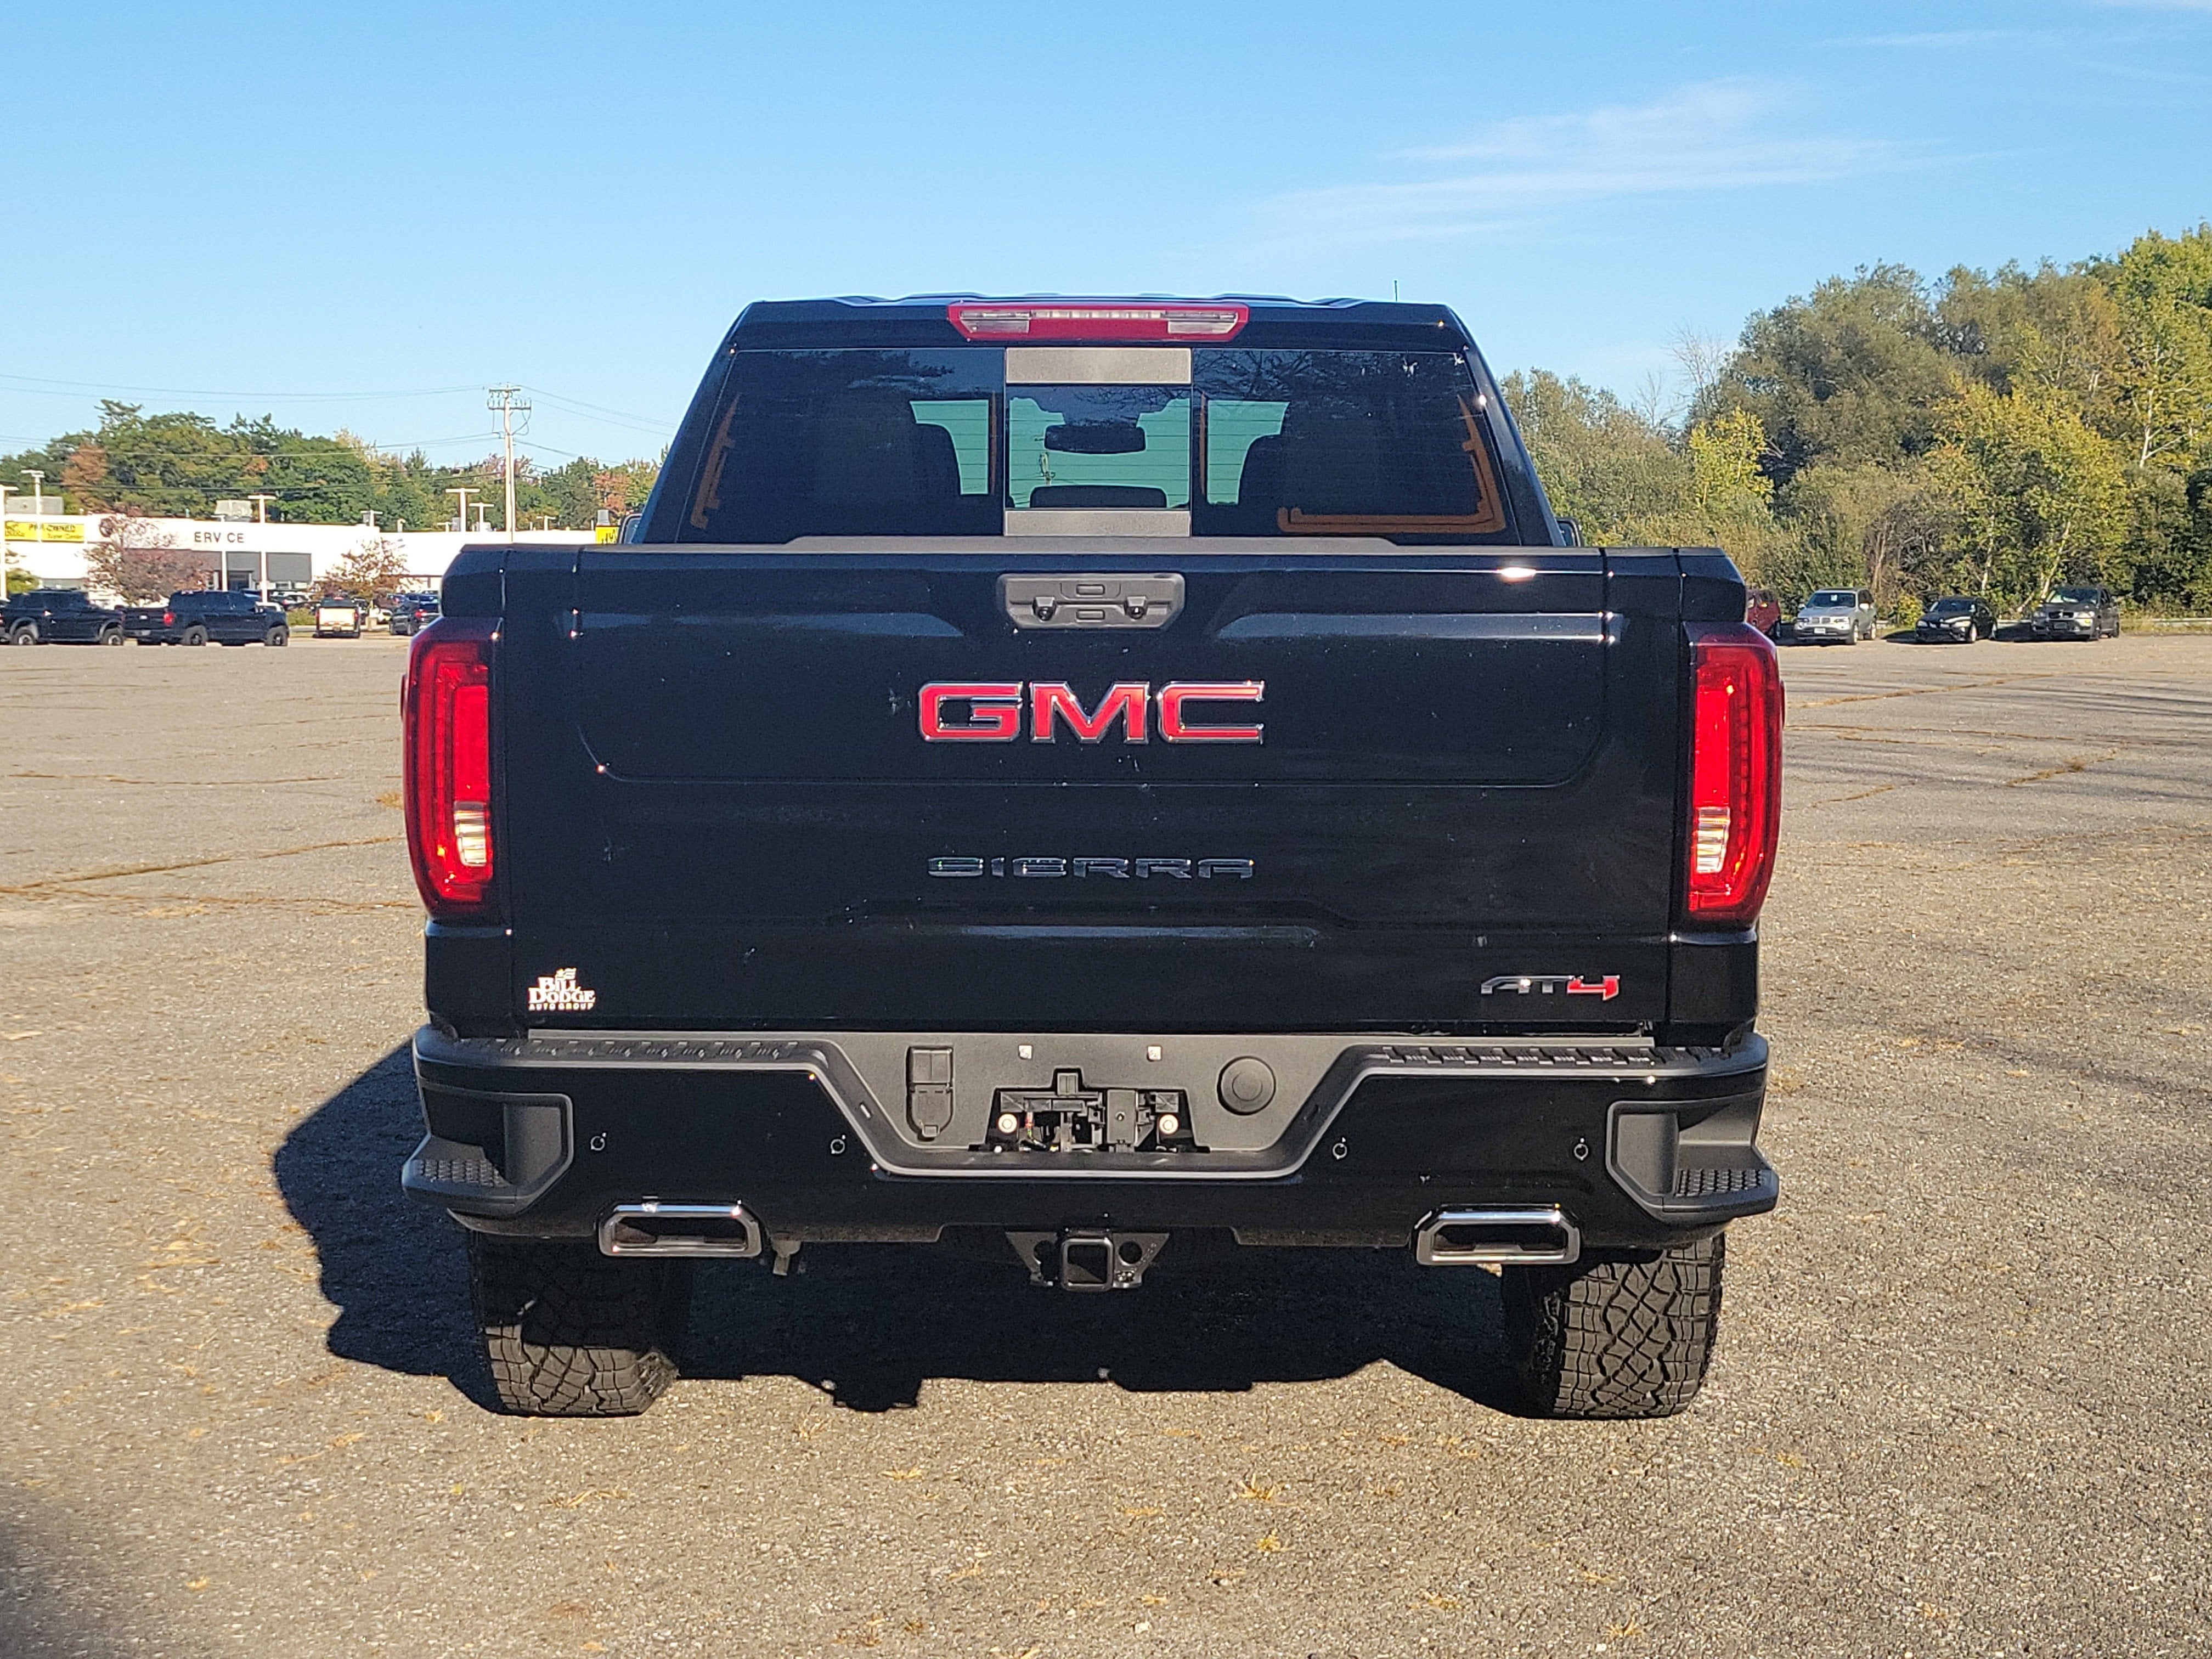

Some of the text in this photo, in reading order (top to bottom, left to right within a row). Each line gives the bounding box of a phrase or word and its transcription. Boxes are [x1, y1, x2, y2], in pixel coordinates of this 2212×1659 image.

[918, 680, 1265, 743] GMC
[928, 856, 1255, 878] SIERRA
[528, 987, 596, 1003] DODGE
[1481, 975, 1620, 1001] AT4
[528, 1002, 556, 1011] AUTO
